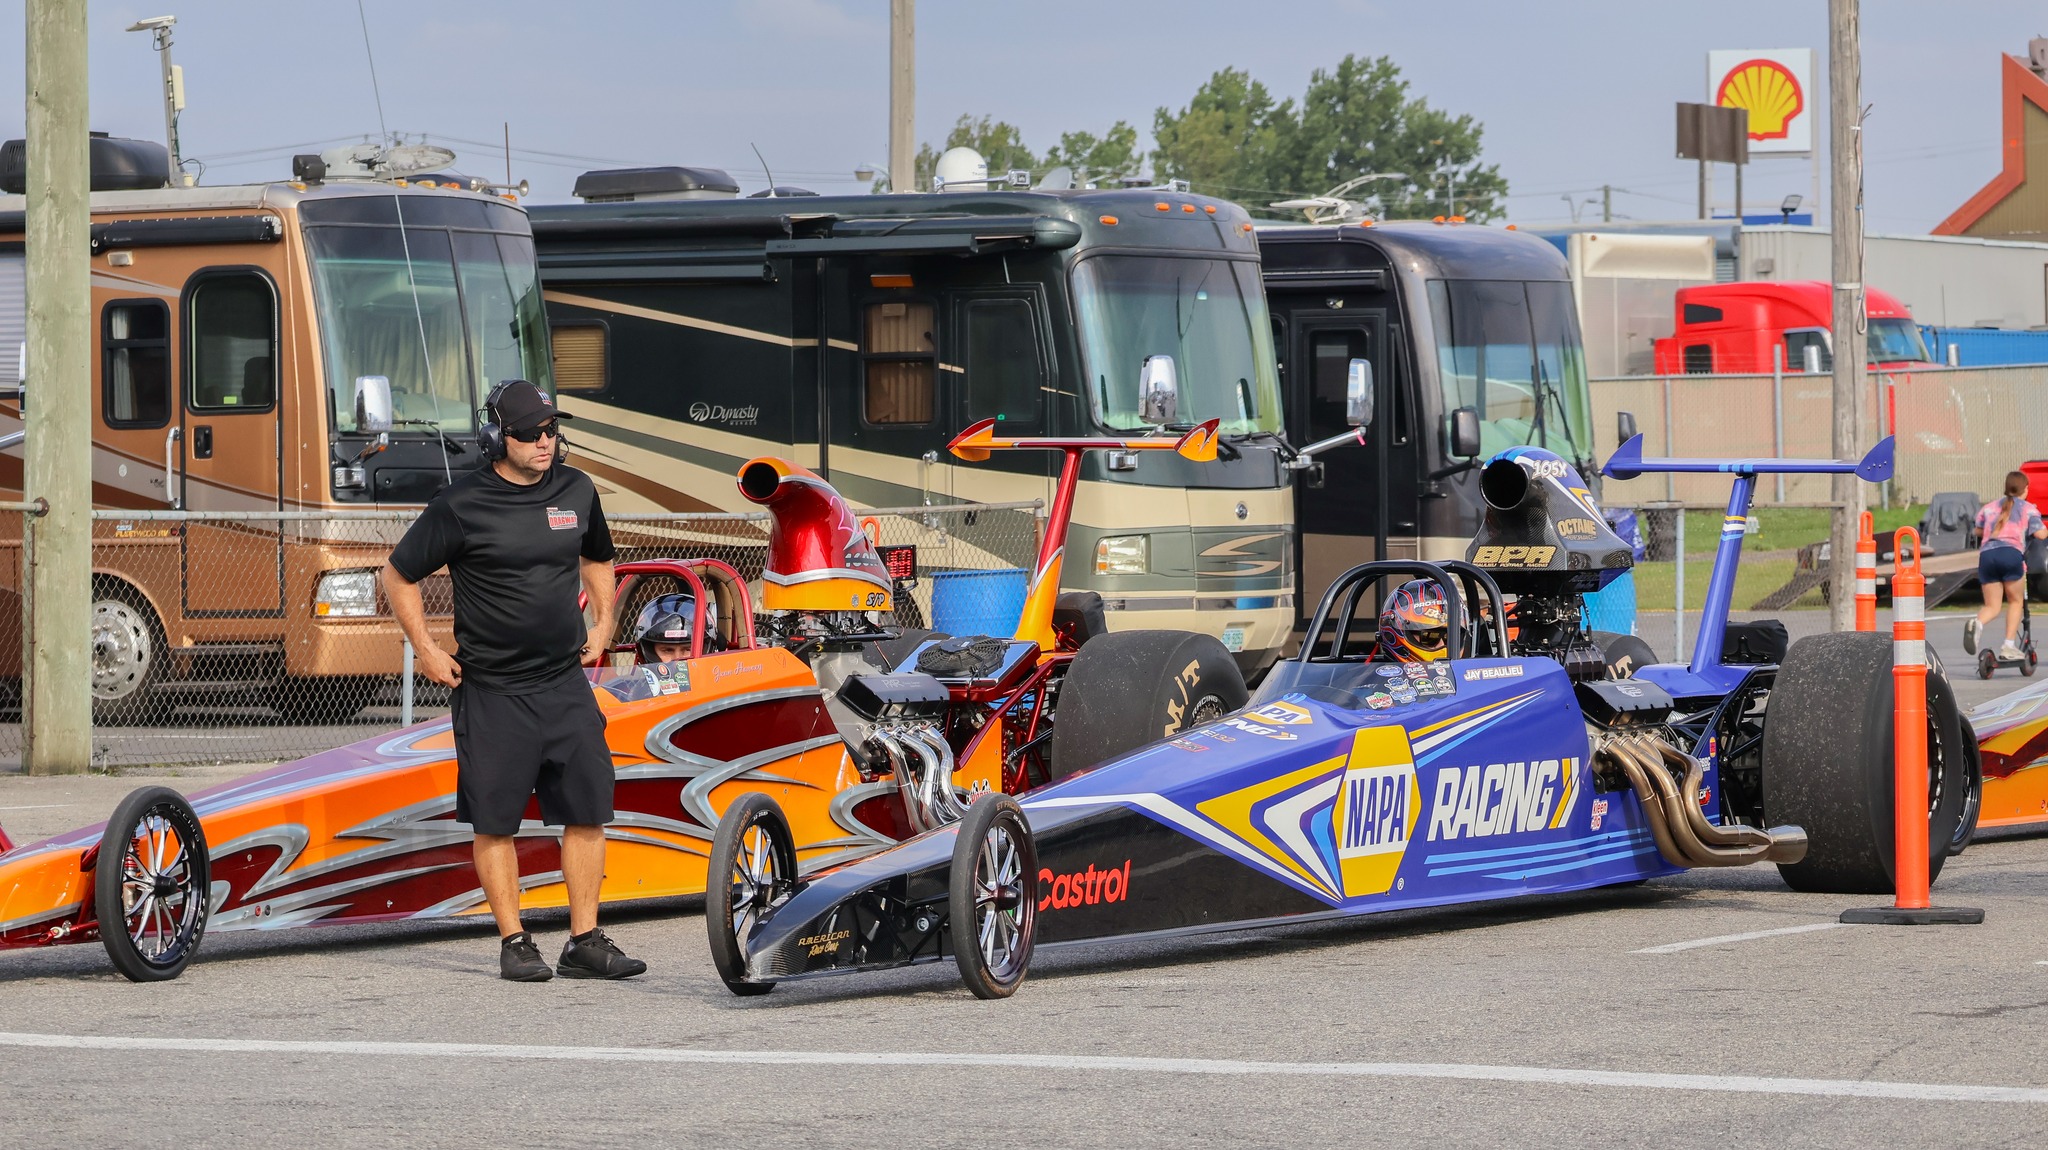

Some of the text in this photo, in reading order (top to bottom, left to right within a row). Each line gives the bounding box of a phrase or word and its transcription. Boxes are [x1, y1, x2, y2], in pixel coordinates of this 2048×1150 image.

[710, 404, 759, 422] Dynasty
[1532, 460, 1567, 479] 105X
[549, 516, 577, 526] DRAGWAY
[1557, 518, 1597, 537] OCTANE
[1472, 546, 1556, 563] BPA
[866, 593, 886, 607] S/P
[1464, 665, 1524, 681] JAY BEAULIEU
[1164, 659, 1200, 738] M/T
[1191, 695, 1219, 718] RACING
[1427, 760, 1559, 841] RACING
[1345, 774, 1406, 848] NAPA
[169, 804, 200, 843] RACING
[1038, 859, 1131, 912] Castrol
[798, 930, 850, 946] AMERICAN
